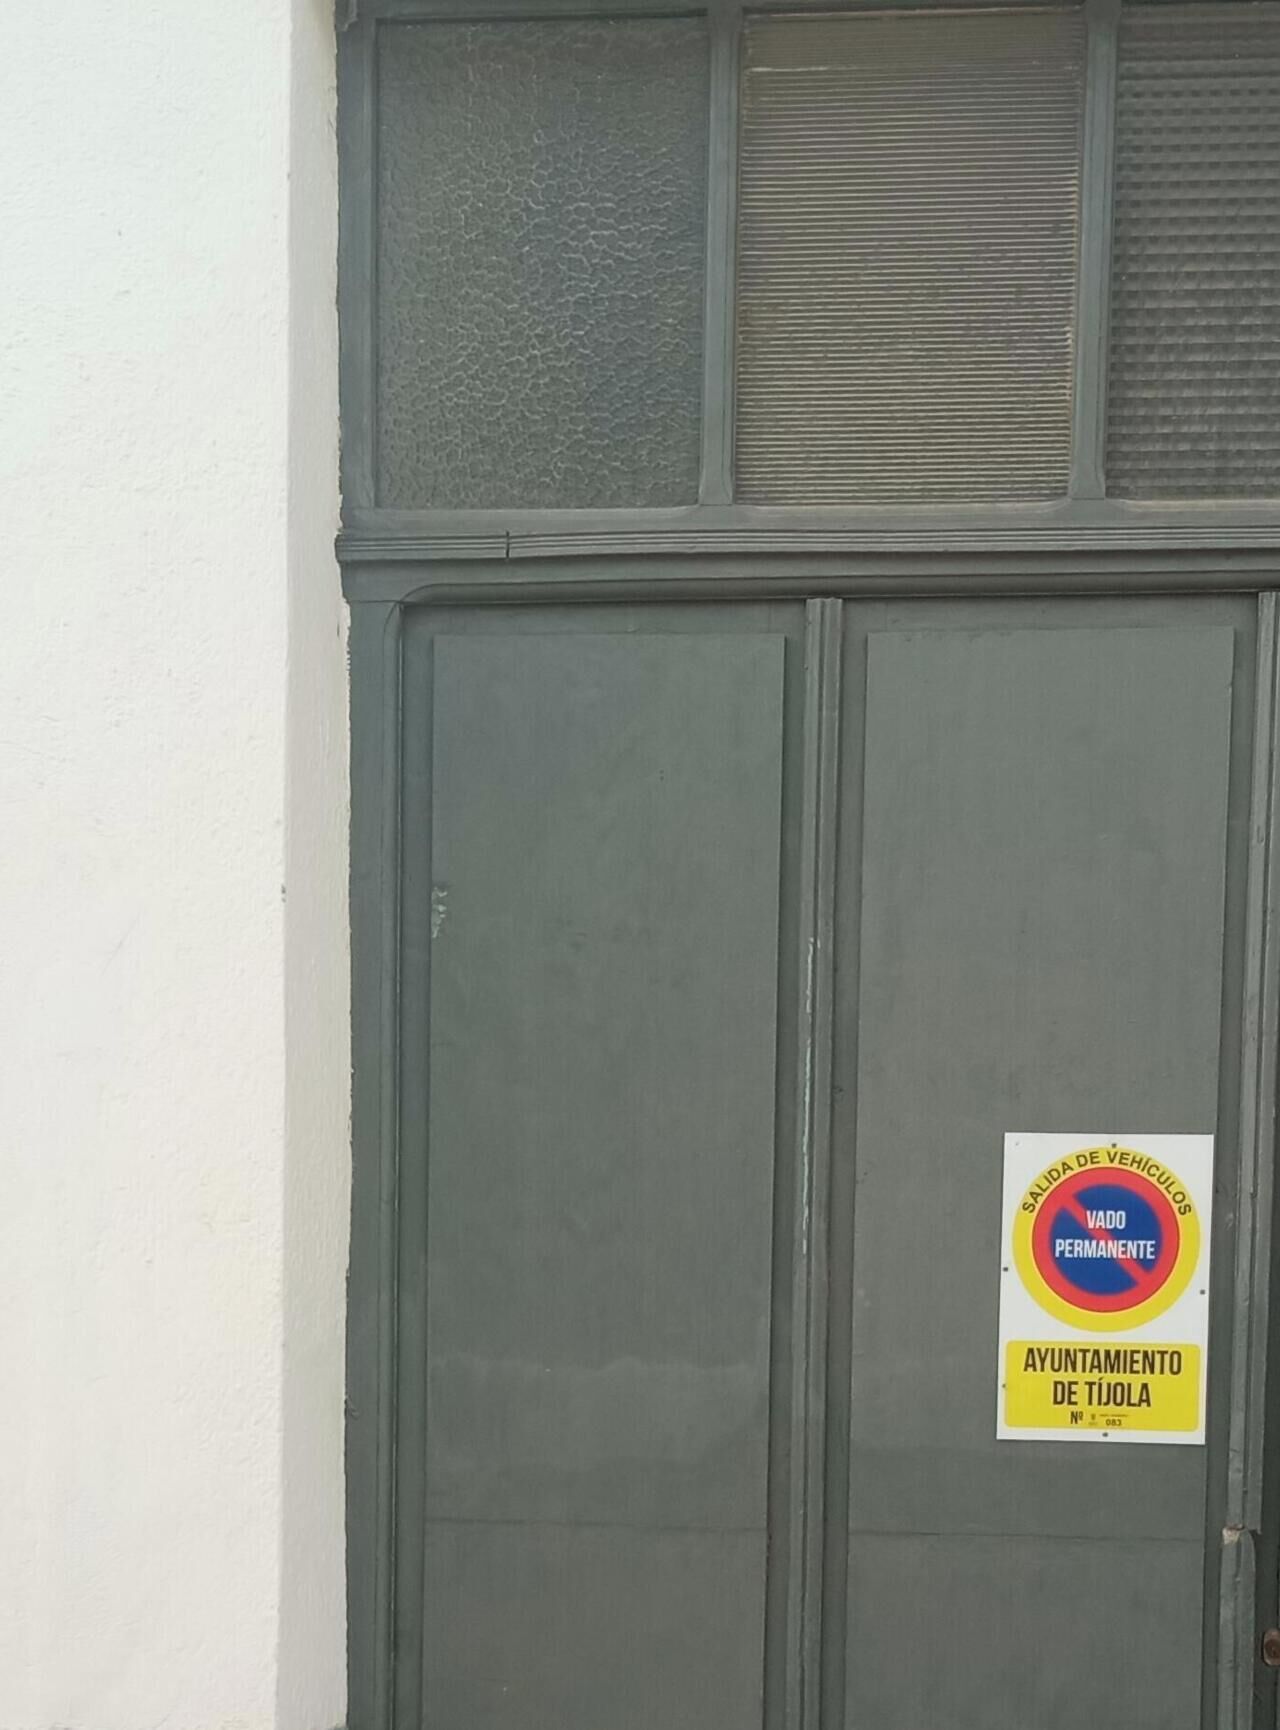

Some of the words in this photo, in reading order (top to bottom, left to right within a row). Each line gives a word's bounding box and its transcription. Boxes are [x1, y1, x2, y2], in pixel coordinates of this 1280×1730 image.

[1022, 1161, 1075, 1214] SALIDA
[1076, 1151, 1101, 1168] DE
[1106, 1151, 1192, 1216] VEHÍCULOS
[1086, 1210, 1126, 1230] VADO
[1055, 1239, 1156, 1260] PERMANENTE
[1023, 1347, 1183, 1376] AYUNTAMIENTO
[1053, 1380, 1079, 1406] DE
[1084, 1377, 1152, 1408] TÍJOLA
[1070, 1410, 1084, 1425] Nº
